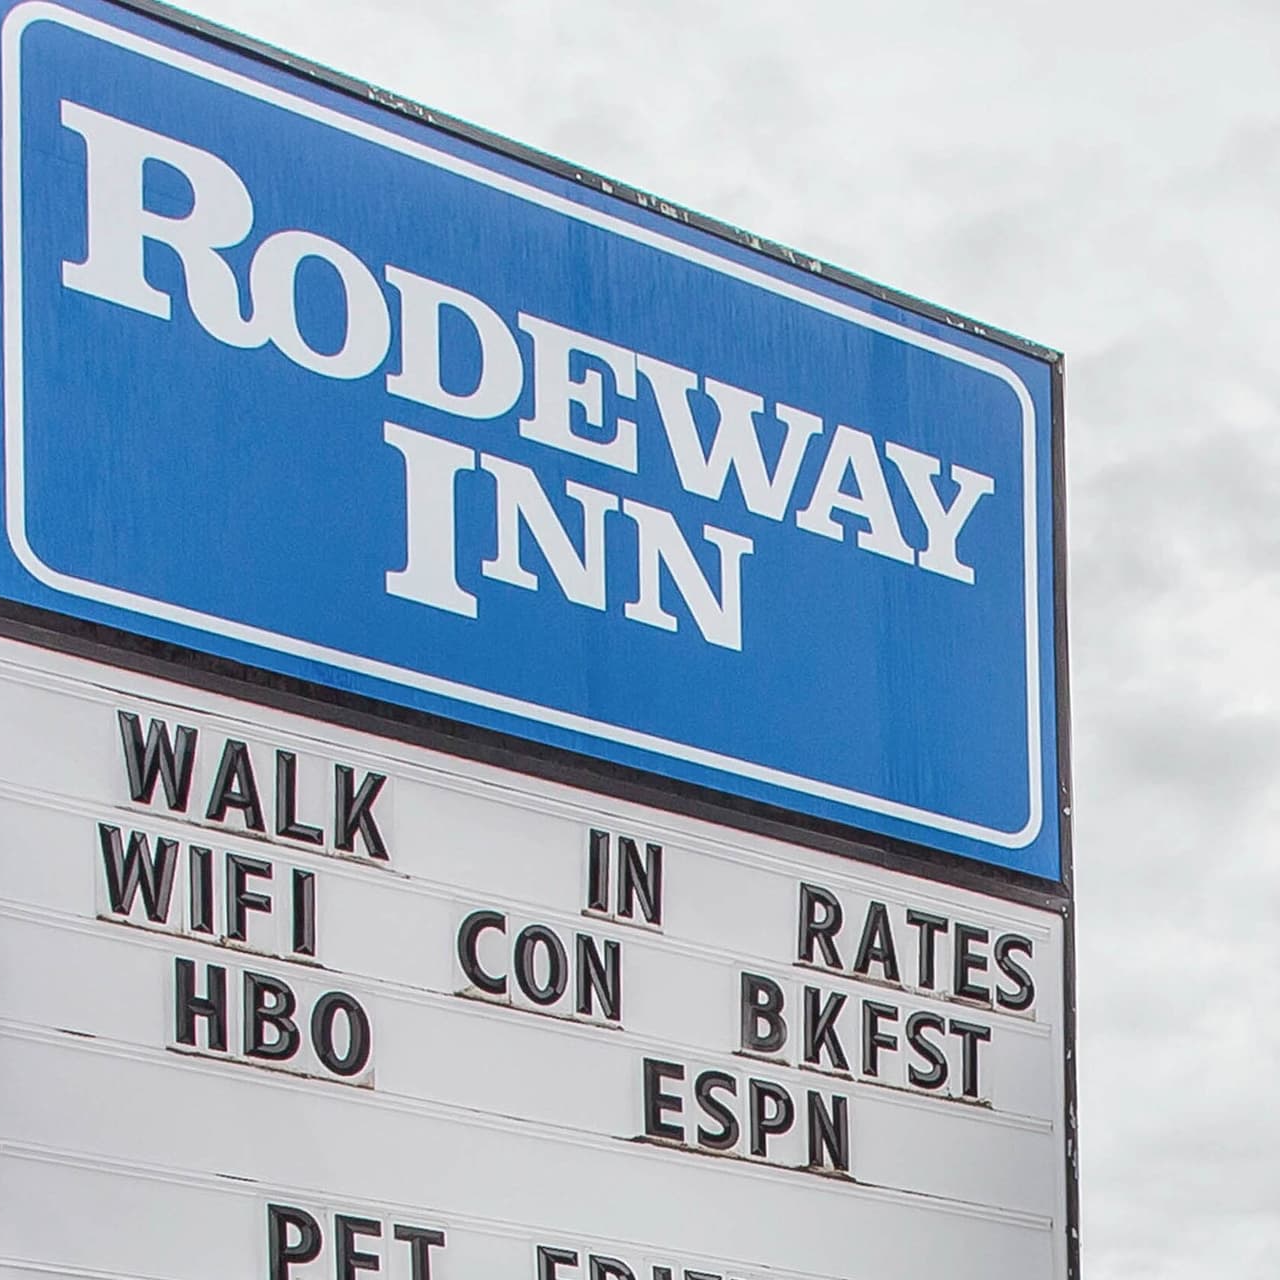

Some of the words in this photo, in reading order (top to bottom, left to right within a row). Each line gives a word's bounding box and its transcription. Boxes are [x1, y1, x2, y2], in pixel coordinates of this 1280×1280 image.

[60, 98, 995, 585] RODEWAY
[384, 421, 754, 652] INN
[96, 823, 317, 956] WIFI
[456, 909, 623, 1021] CON
[741, 972, 993, 1101] BKFST
[116, 709, 390, 862] WALK
[586, 827, 665, 926] IN
[798, 881, 1036, 1011] RATES
[173, 957, 373, 1078] HBO
[642, 1057, 851, 1173] ESPN
